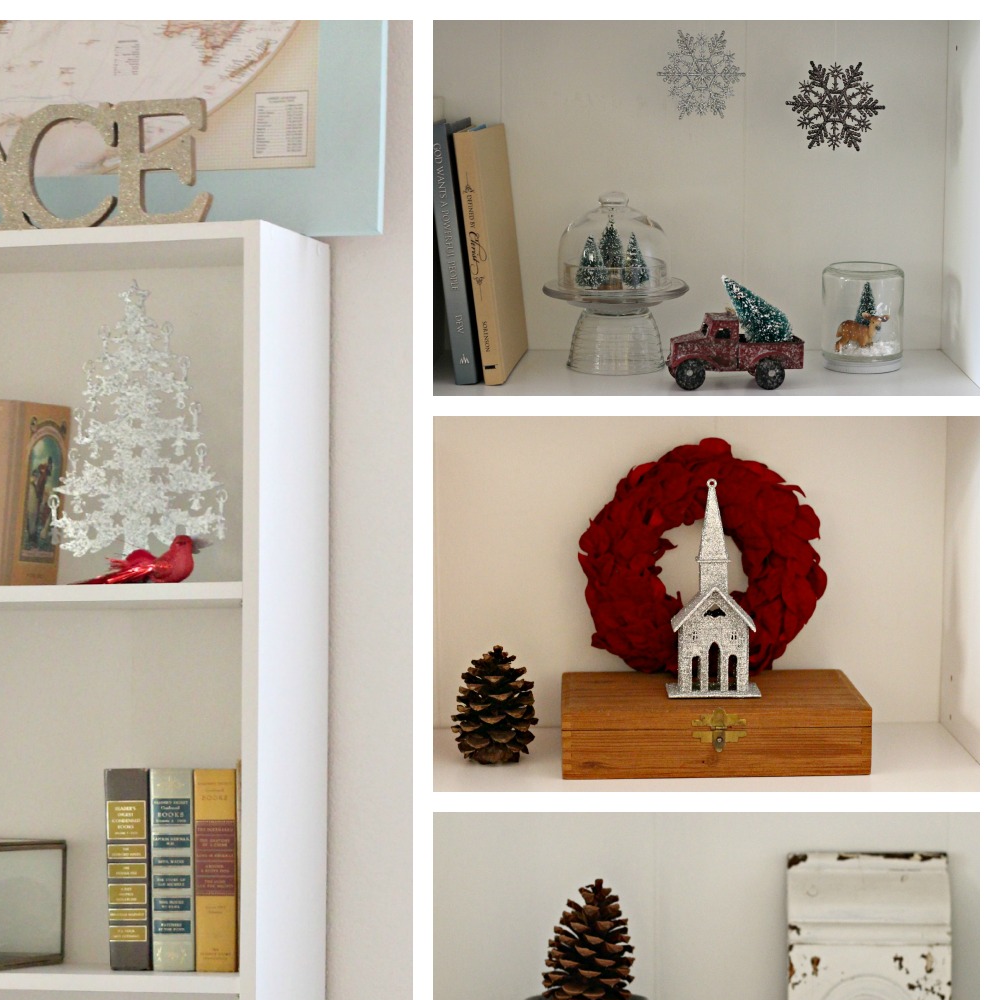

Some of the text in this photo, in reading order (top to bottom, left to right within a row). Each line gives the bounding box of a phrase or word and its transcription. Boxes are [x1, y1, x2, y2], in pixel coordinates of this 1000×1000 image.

[433, 143, 442, 164] GOD
[436, 166, 447, 199] WANTS
[466, 195, 474, 220] DEFINED
[441, 210, 453, 257] POWERFUL
[468, 231, 487, 274] Christ
[448, 261, 459, 291] PEOPLE
[454, 314, 464, 334] DEW
[482, 321, 490, 352] SORENSON
